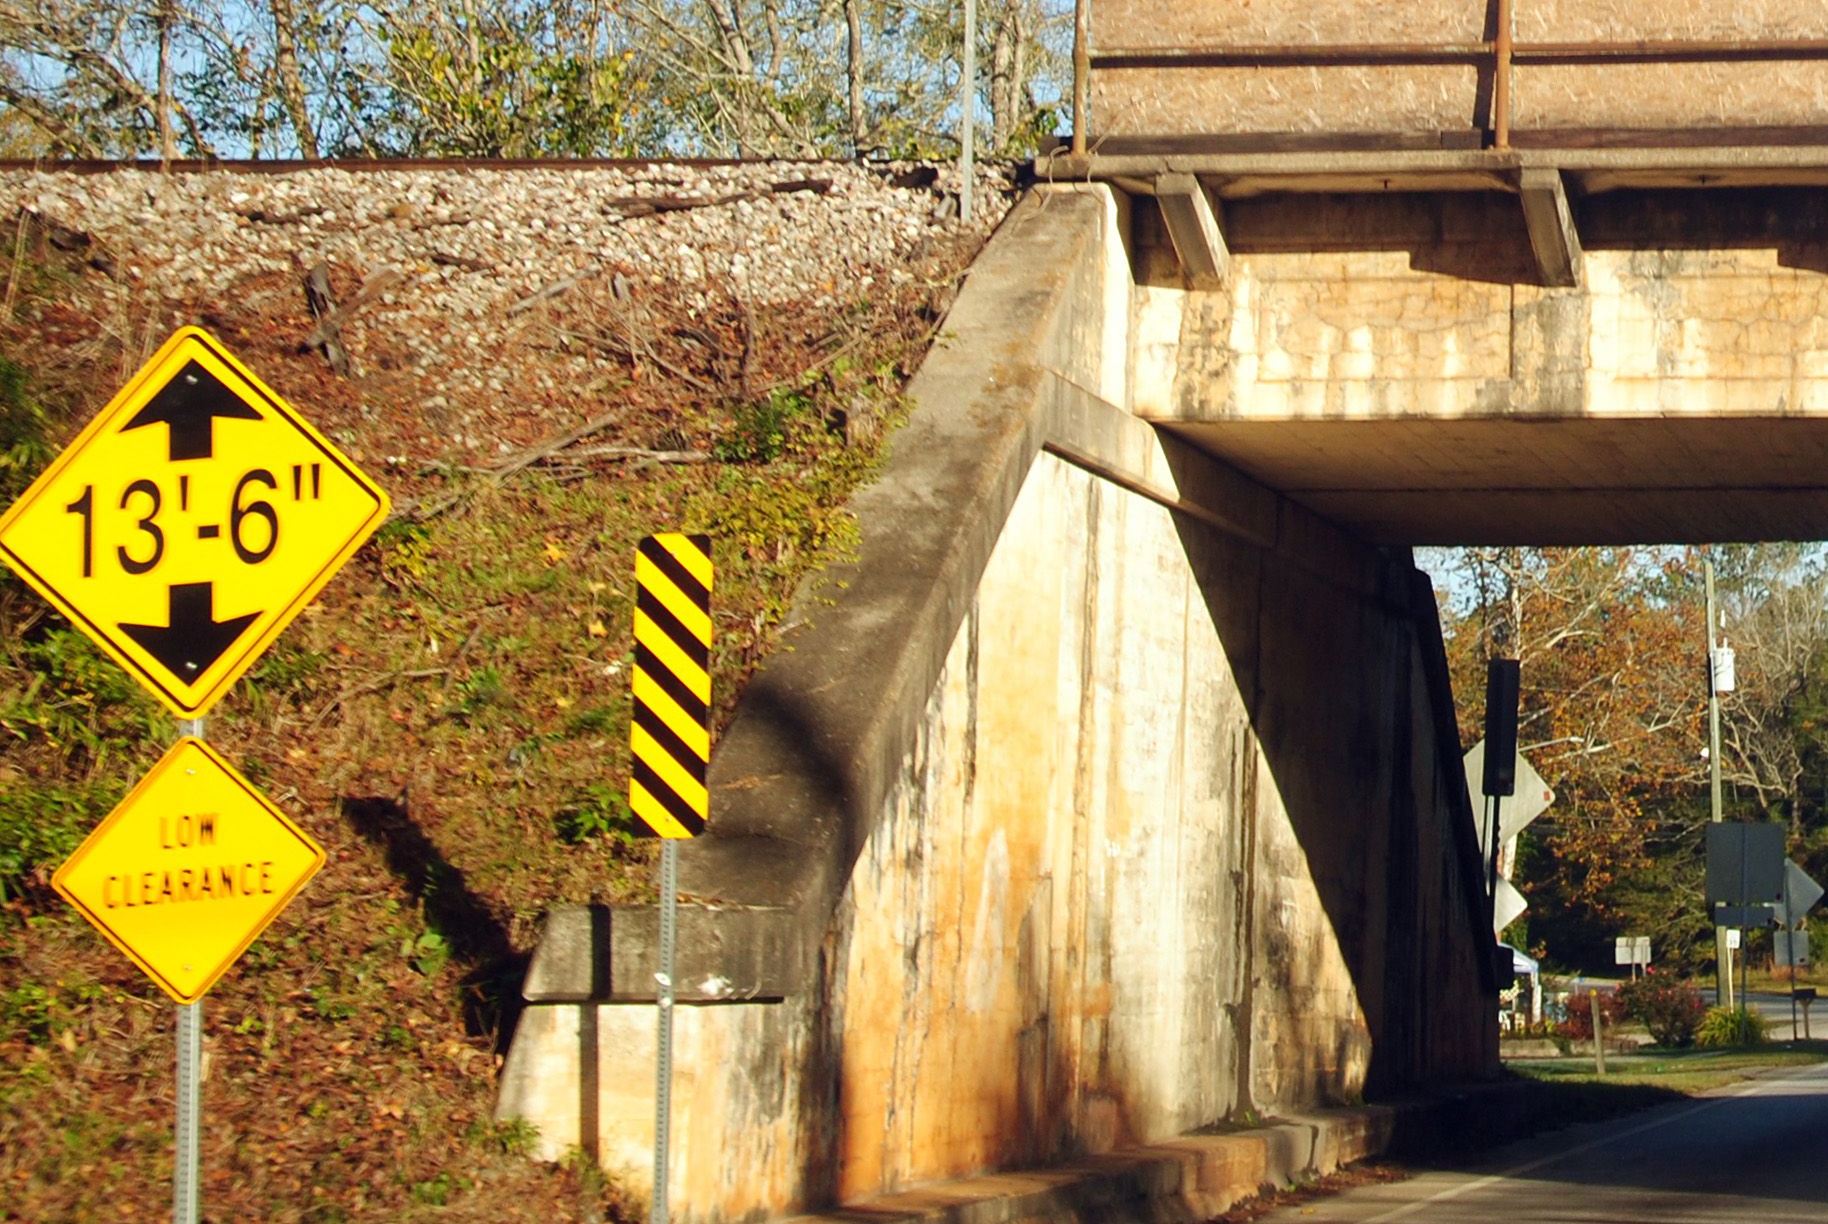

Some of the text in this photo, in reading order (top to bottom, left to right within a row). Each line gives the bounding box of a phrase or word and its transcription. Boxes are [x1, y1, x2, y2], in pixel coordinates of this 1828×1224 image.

[66, 463, 321, 578] 13'-6"
[159, 813, 219, 849] LOW
[103, 862, 274, 909] CLEARANCE
